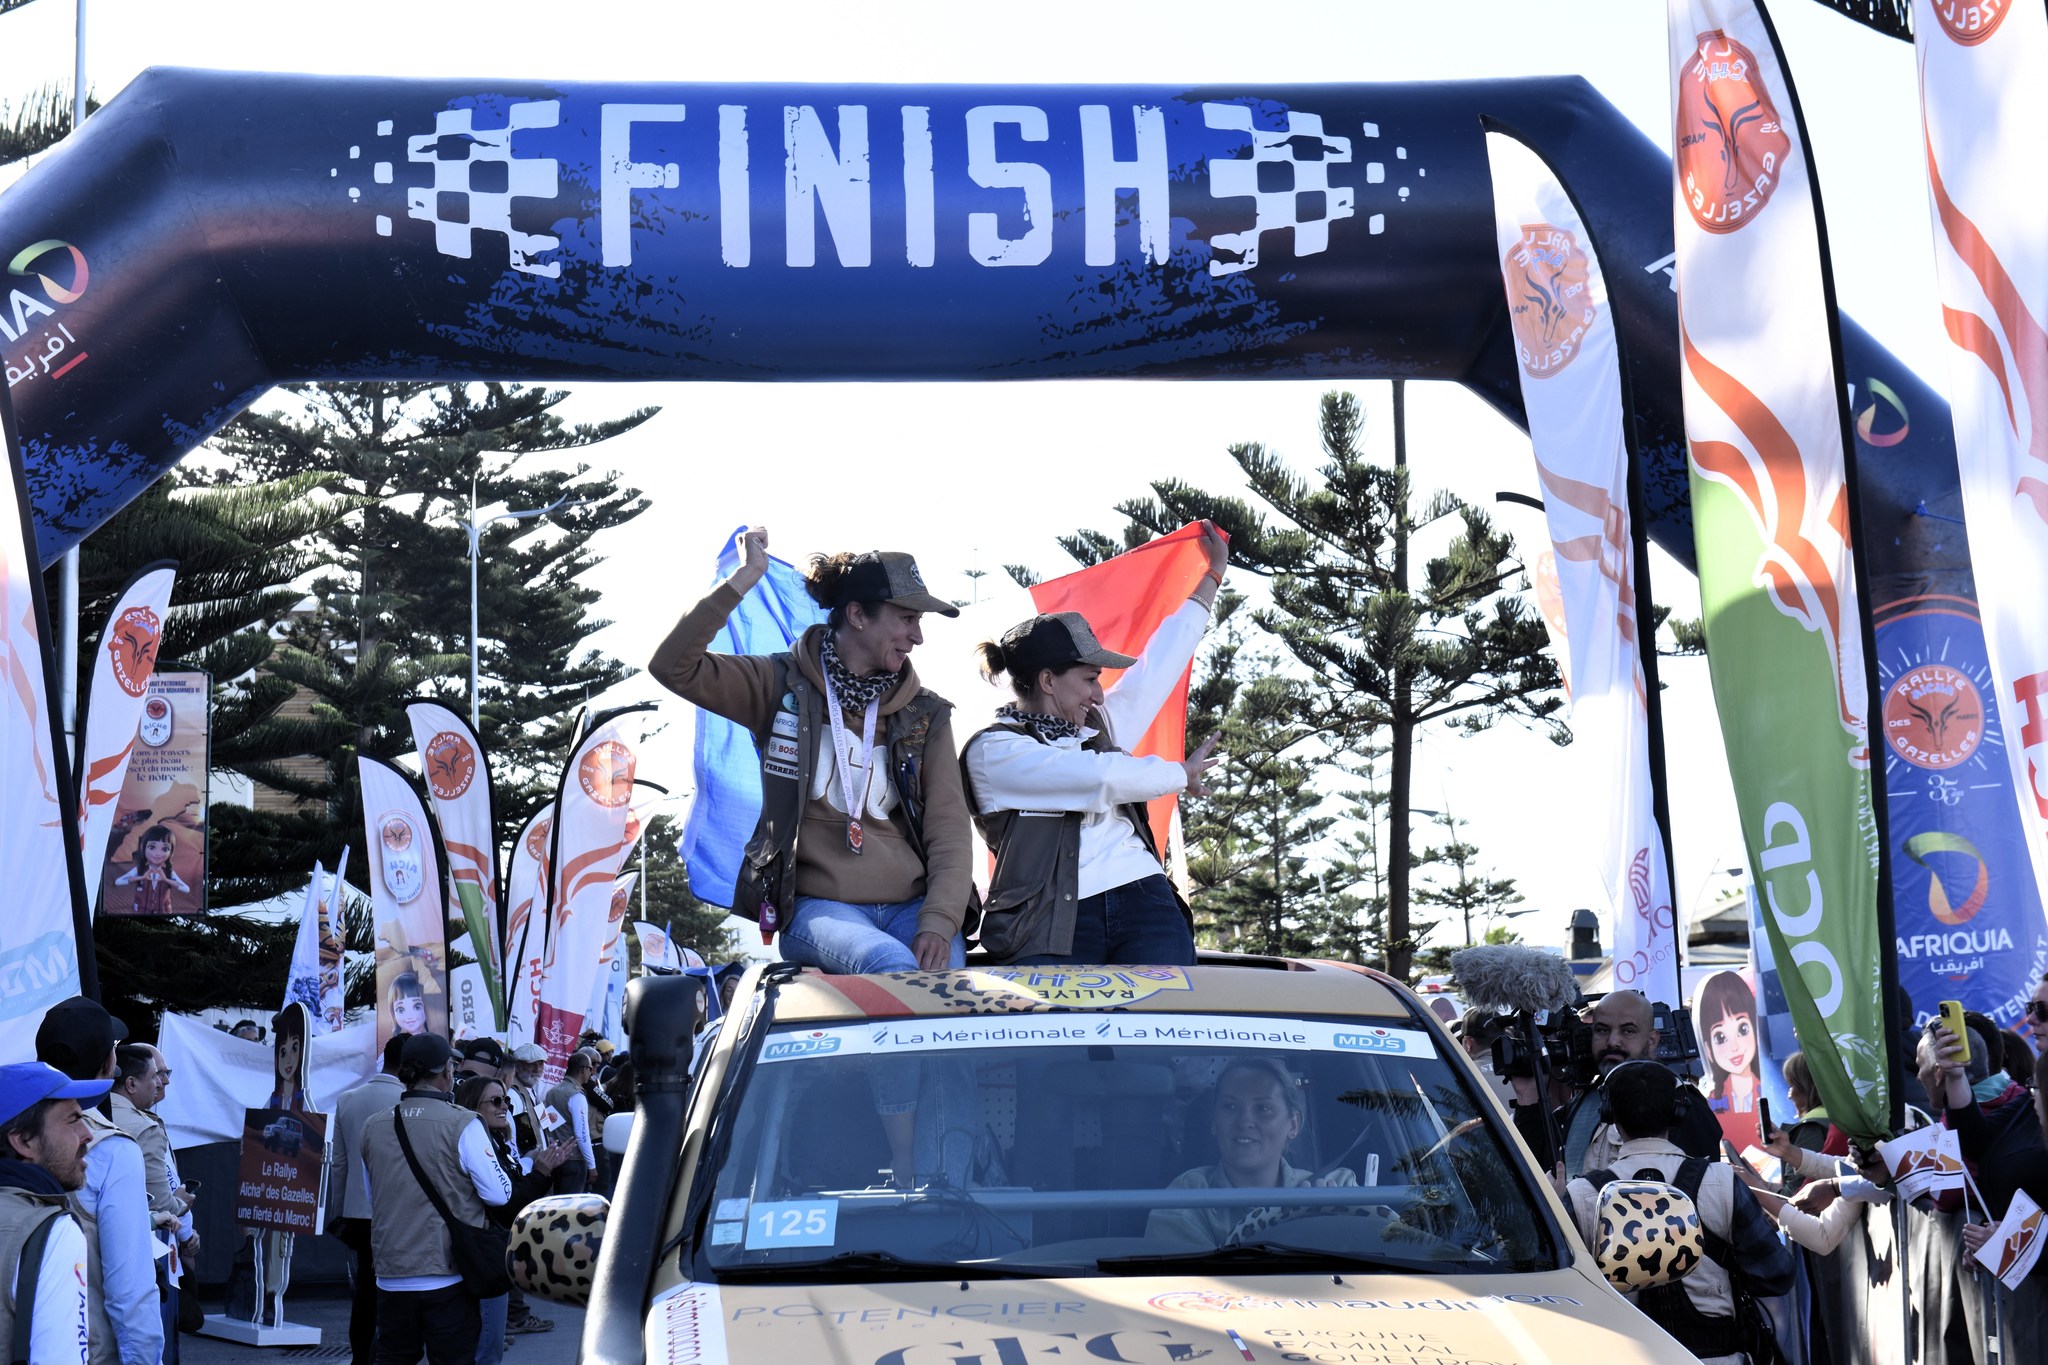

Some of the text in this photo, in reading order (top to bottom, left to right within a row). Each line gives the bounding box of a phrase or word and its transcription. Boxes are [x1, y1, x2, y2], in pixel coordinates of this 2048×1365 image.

[601, 103, 1170, 267] FINISH
[1897, 670, 1966, 695] RALLYE
[834, 717, 843, 748] GAZELLES
[1888, 719, 1911, 727] DES
[1896, 730, 1977, 763] GAZELLES
[582, 777, 631, 804] GAZELLES
[1896, 928, 2014, 958] AFRIQUIA
[1039, 989, 1135, 999] RALLYE
[895, 1026, 1306, 1045] La Méridionale La Méridionale
[1338, 1034, 1401, 1050] MDJS
[769, 1039, 836, 1056] MDJS
[391, 1107, 424, 1117] SAFF
[262, 1161, 298, 1181] Le Rallye
[265, 1184, 279, 1200] des
[281, 1186, 316, 1206] Gazelles,
[238, 1207, 252, 1219] une
[253, 1206, 272, 1222] fierté
[273, 1208, 284, 1223] du
[284, 1209, 310, 1227] Maroc
[759, 1208, 827, 1237] 125
[732, 1301, 1086, 1323] POTENCIER
[1264, 1328, 1443, 1343] GROUPE
[1273, 1340, 1469, 1357] FAMILIAL
